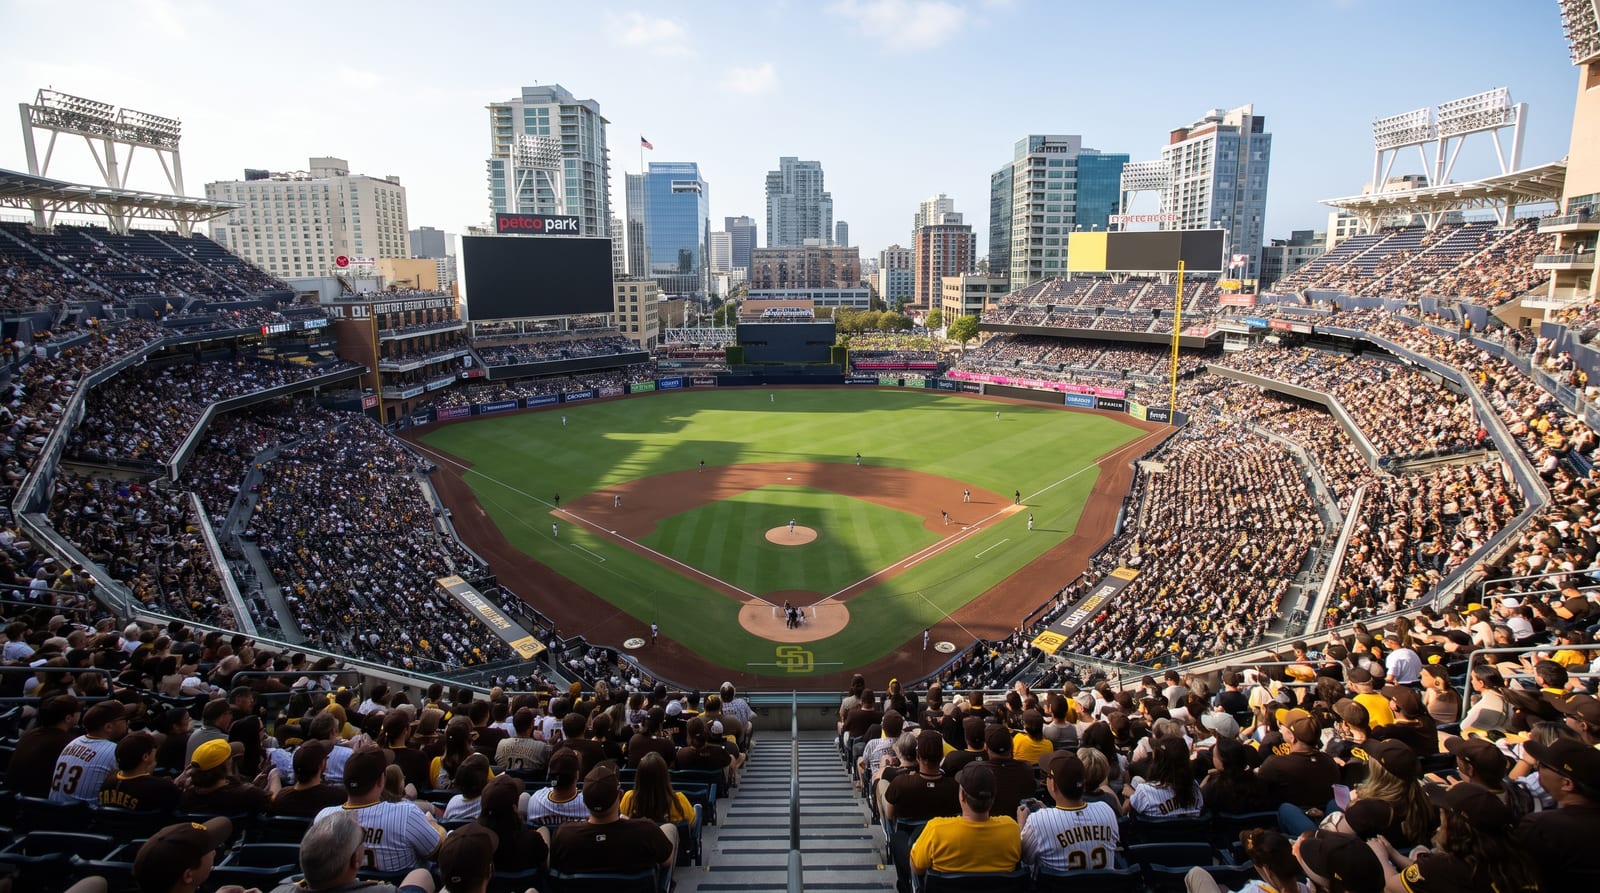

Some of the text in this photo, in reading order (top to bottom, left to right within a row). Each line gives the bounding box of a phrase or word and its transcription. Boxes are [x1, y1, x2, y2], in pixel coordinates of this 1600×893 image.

[498, 215, 578, 233] petco park
[775, 645, 815, 673] SD
[52, 761, 83, 795] 23
